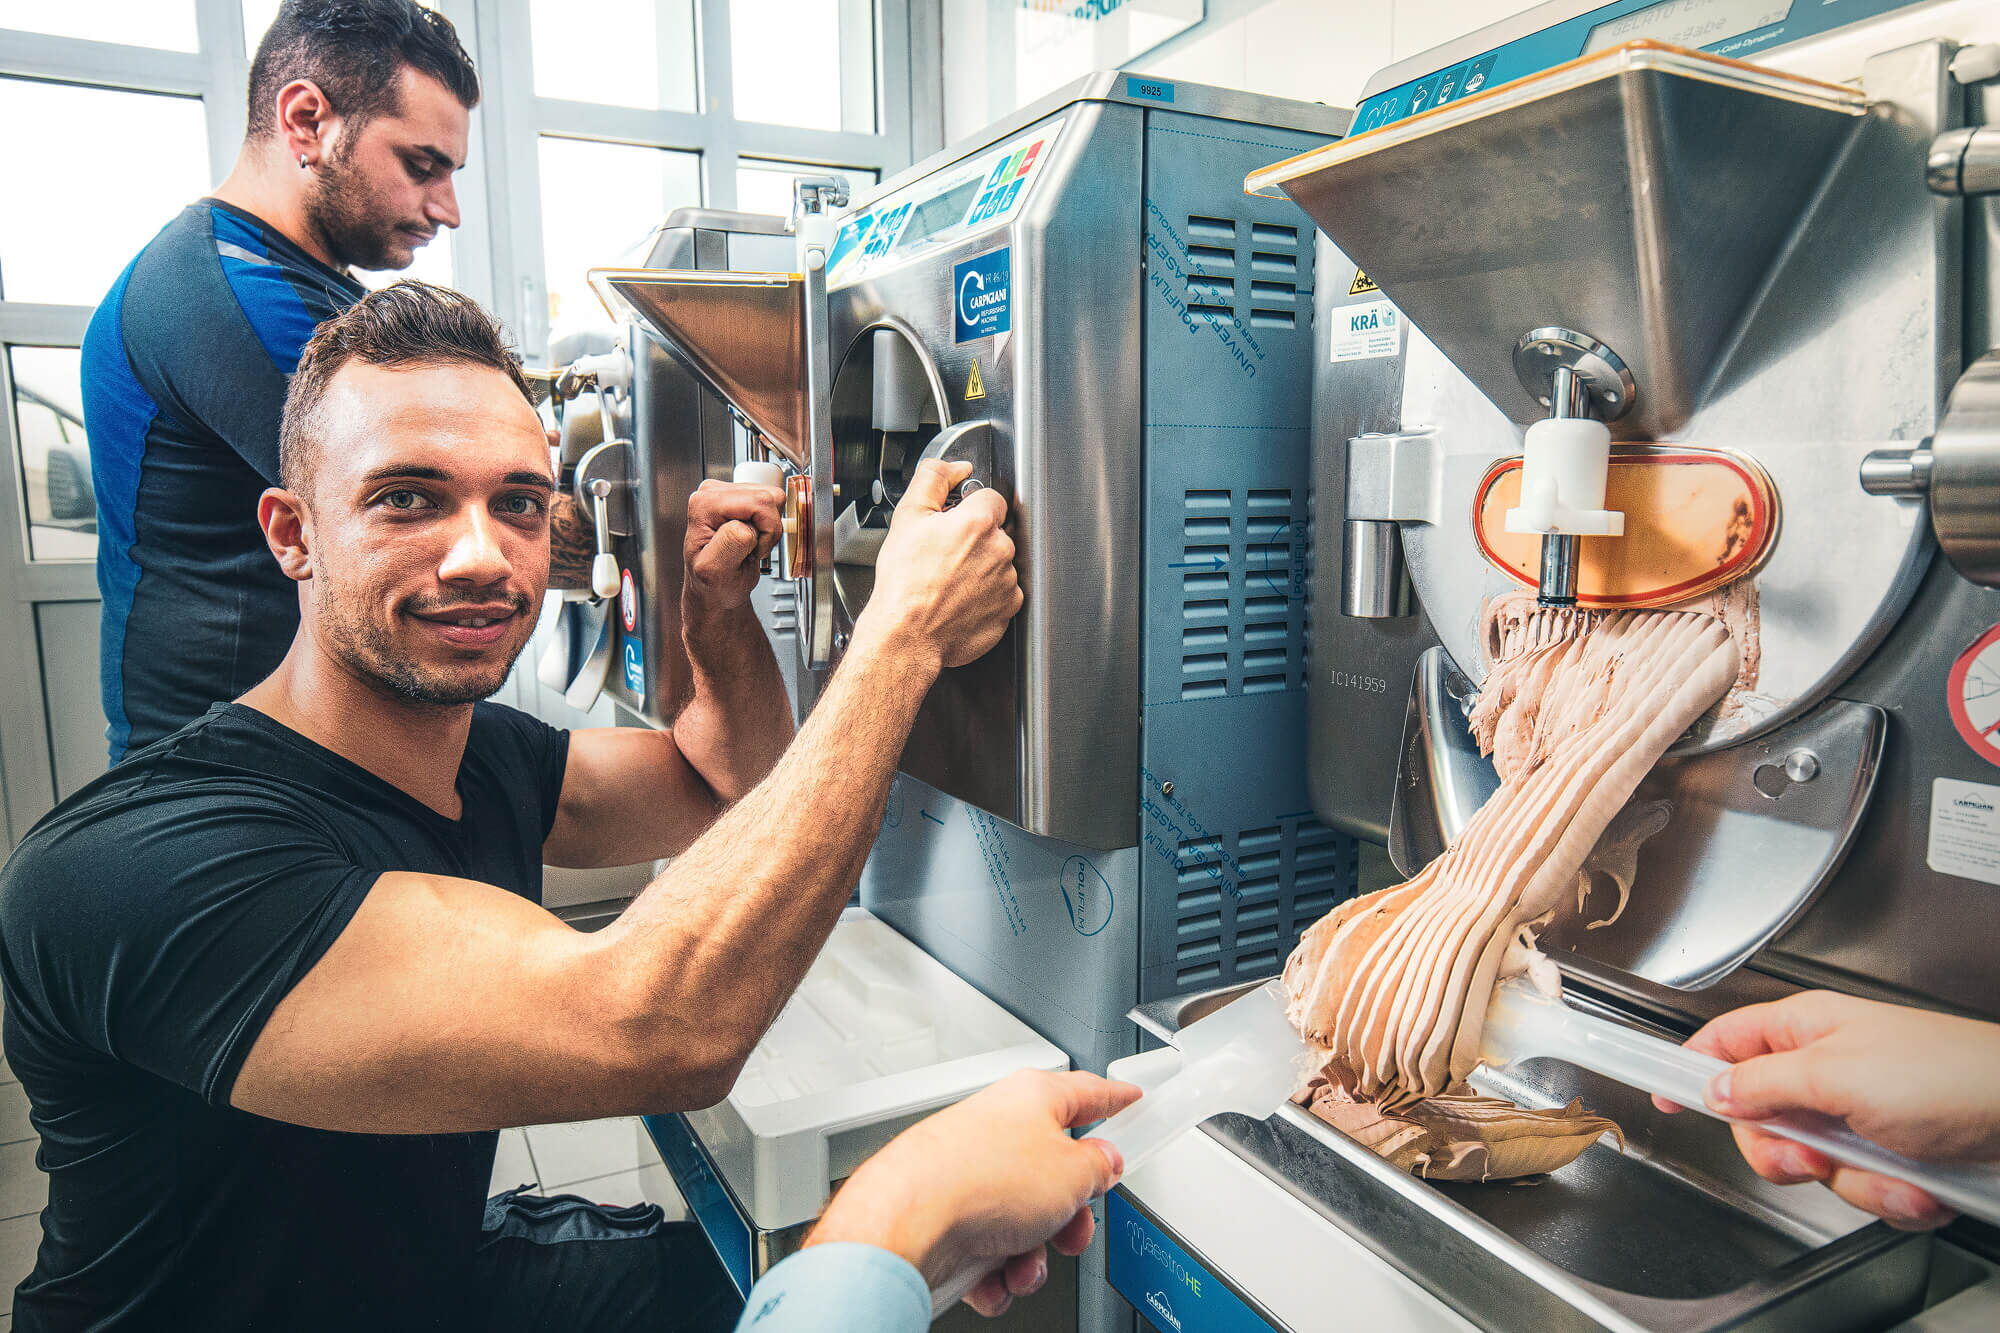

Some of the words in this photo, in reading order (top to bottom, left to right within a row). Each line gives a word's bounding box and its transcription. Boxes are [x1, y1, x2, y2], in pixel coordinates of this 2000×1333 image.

[1140, 84, 1162, 97] 9925
[970, 288, 1007, 309] CARPIGIANI
[980, 305, 1007, 316] REFURBISHED
[1151, 271, 1200, 334] POLIFILM
[980, 315, 998, 324] MACHINE
[1351, 308, 1379, 331] KRÄ
[1240, 328, 1265, 360] FIBER
[1293, 524, 1304, 595] POLIFILM
[1330, 670, 1386, 694] IC141959
[988, 815, 1010, 864] OLIFILM
[1077, 862, 1085, 930] POLIFILM
[1146, 1291, 1181, 1330] CARPIGIANI
